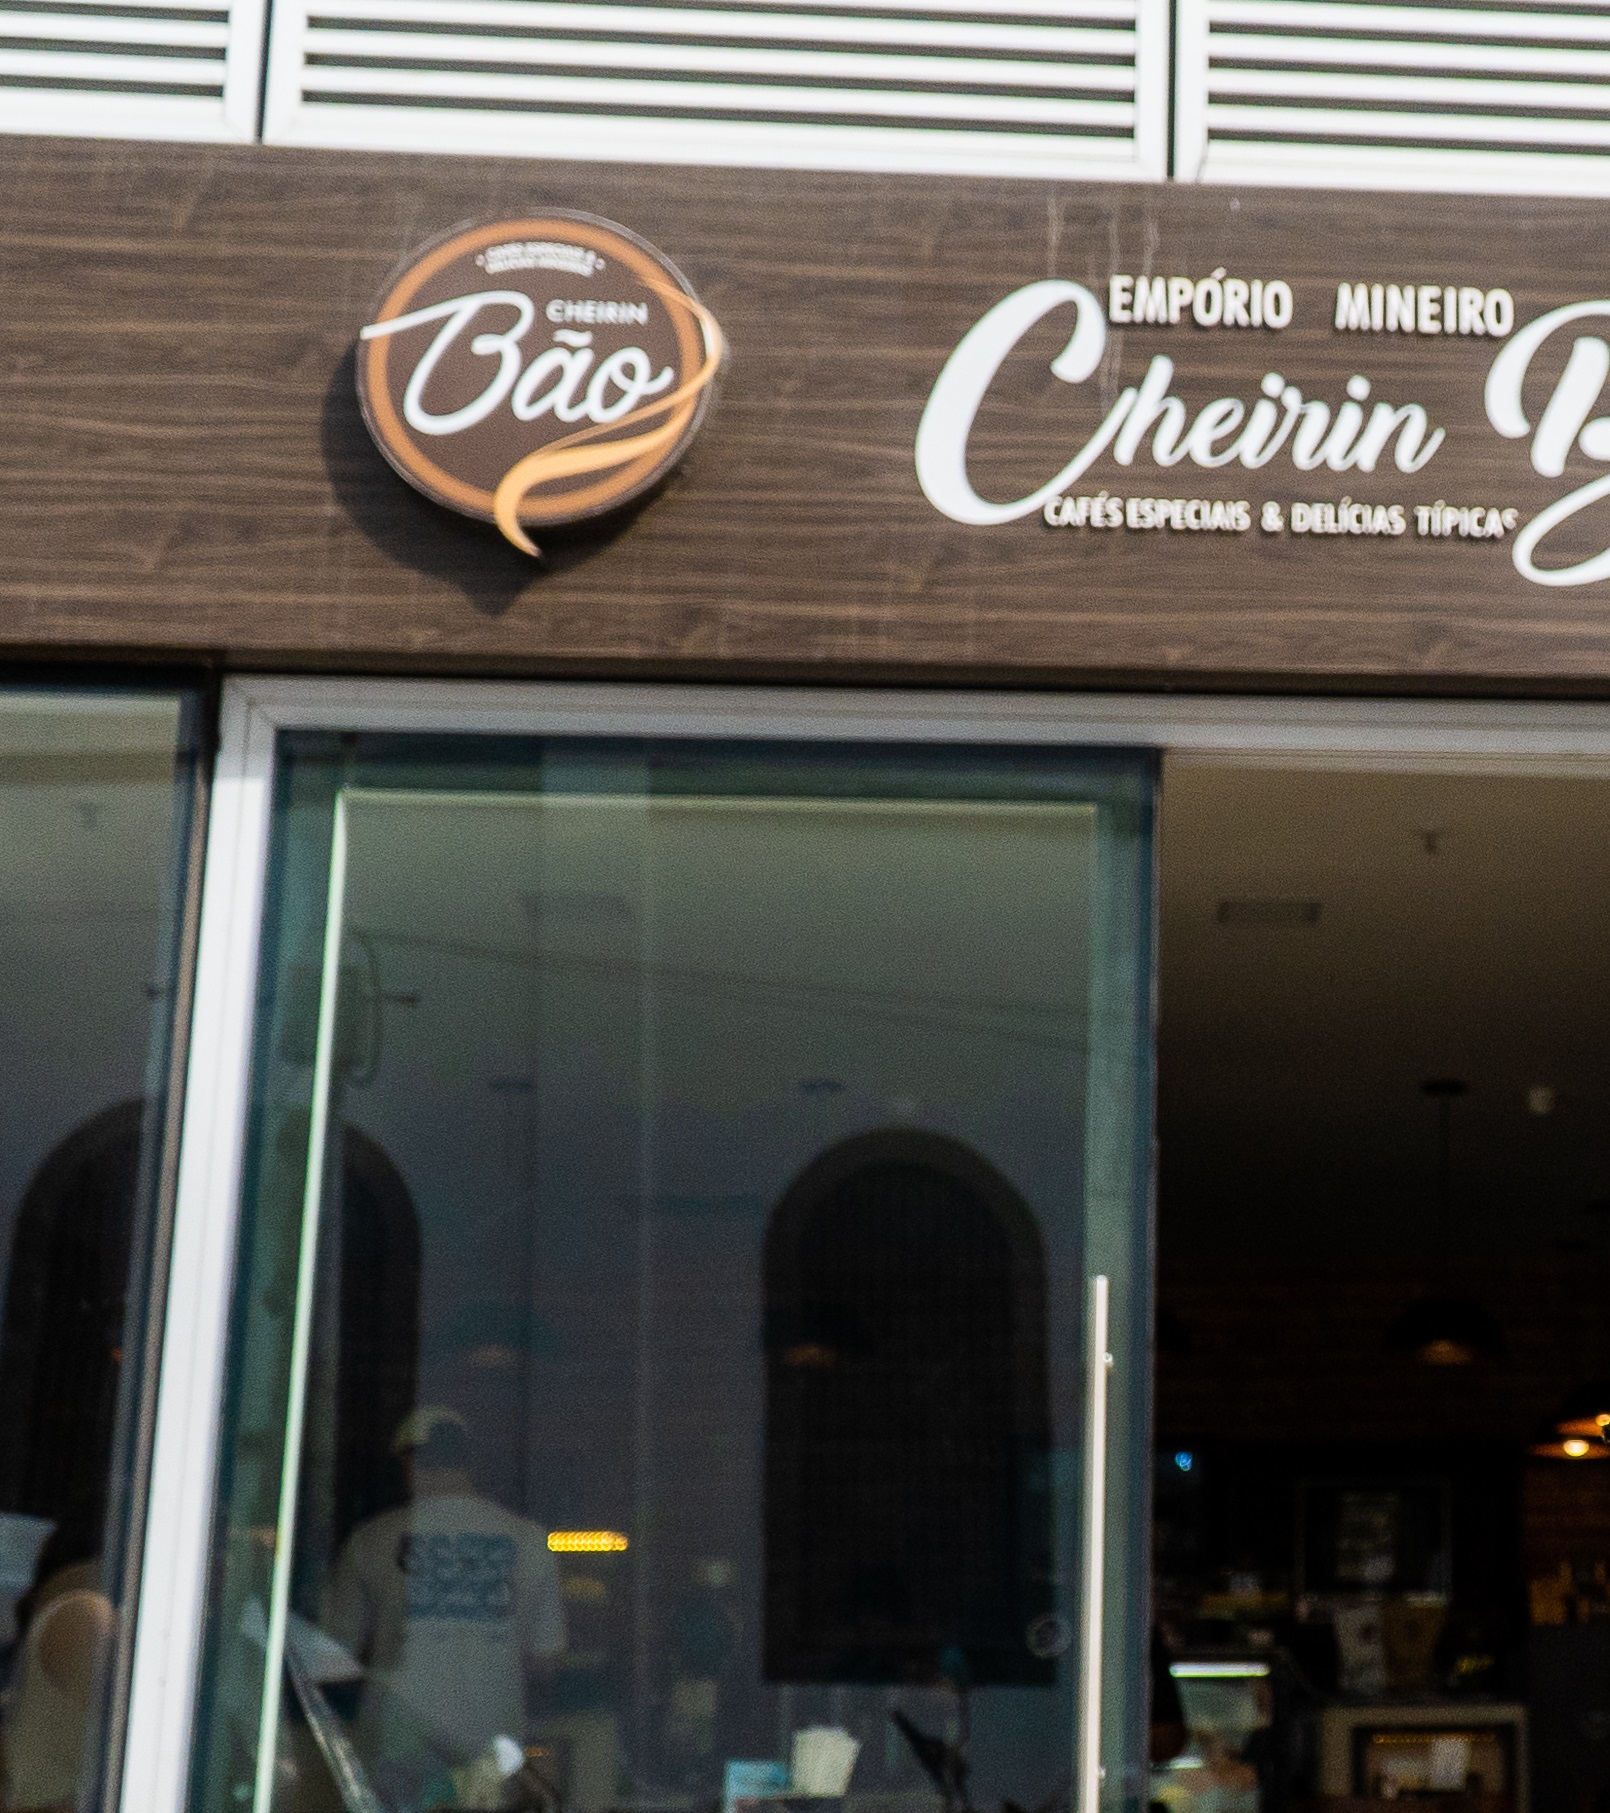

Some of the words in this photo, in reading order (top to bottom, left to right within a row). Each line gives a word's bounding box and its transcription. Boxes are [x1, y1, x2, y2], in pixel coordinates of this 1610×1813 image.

[546, 299, 649, 325] CHEIRIN
[1108, 266, 1293, 328] EMPÓRIO
[1334, 282, 1514, 336] MINEIRO
[360, 290, 675, 435] Bão
[914, 278, 1446, 526] Cheirin
[1043, 490, 1124, 528] CAFÉS
[1126, 497, 1251, 531] ESPECIAIS
[1261, 501, 1283, 533] &
[1291, 496, 1406, 535] DELÍCIAS
